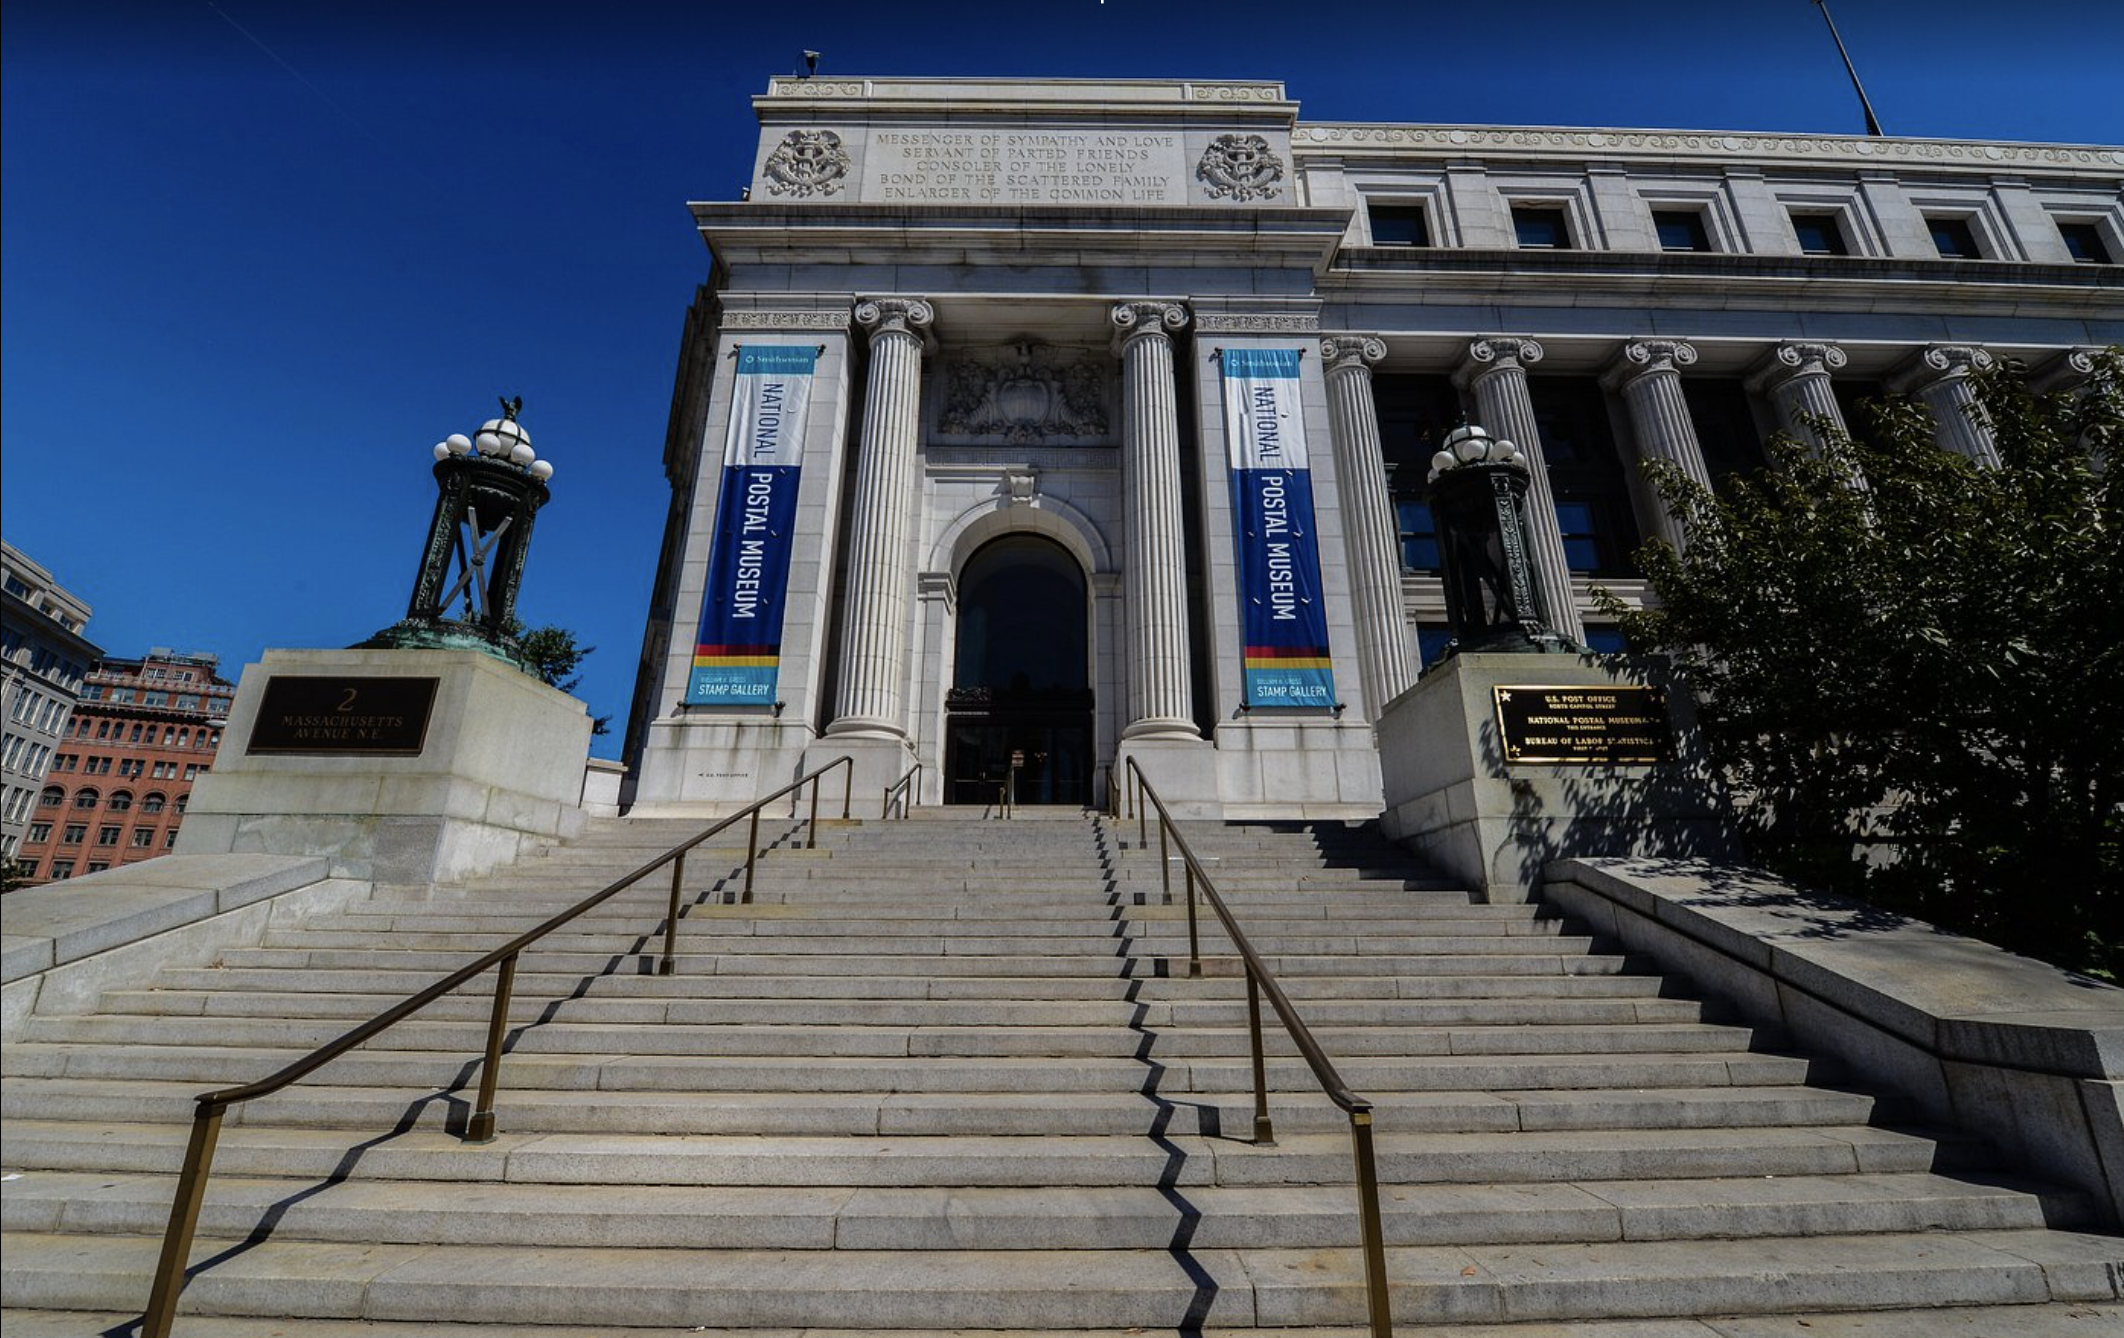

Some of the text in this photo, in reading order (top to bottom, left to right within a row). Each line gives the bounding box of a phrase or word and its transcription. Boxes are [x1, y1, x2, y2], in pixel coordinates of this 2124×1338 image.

[877, 134, 1174, 147] MESSENGER OF SYMPATHY AND LOVE
[902, 148, 1149, 160] SERVANT OF PARTED FRIENDS
[917, 161, 1135, 173] CONSOLER OF THE LONELY
[880, 174, 1170, 187] BOND OF THE SCATTERED FAMILY
[884, 187, 1166, 200] ENLARGER OF THE COMMON LIFE
[732, 383, 784, 619] NATIONAL POSTAL MUSEUM
[1253, 386, 1297, 621] NATIONAL POSTAL MUSEUM
[698, 683, 769, 696] STAMP GALLERY
[1257, 685, 1327, 697] STAMP GALLERY
[337, 687, 358, 711] 2
[1545, 695, 1560, 703] U.S.
[1562, 695, 1584, 703] POST
[280, 715, 404, 728] MASSACHUSETTS
[1527, 716, 1570, 724] NATIONAL
[293, 728, 351, 739] AVENUE
[1524, 737, 1558, 745] BUREAU
[1560, 737, 1572, 745] OF
[1575, 737, 1604, 745] LABOR
